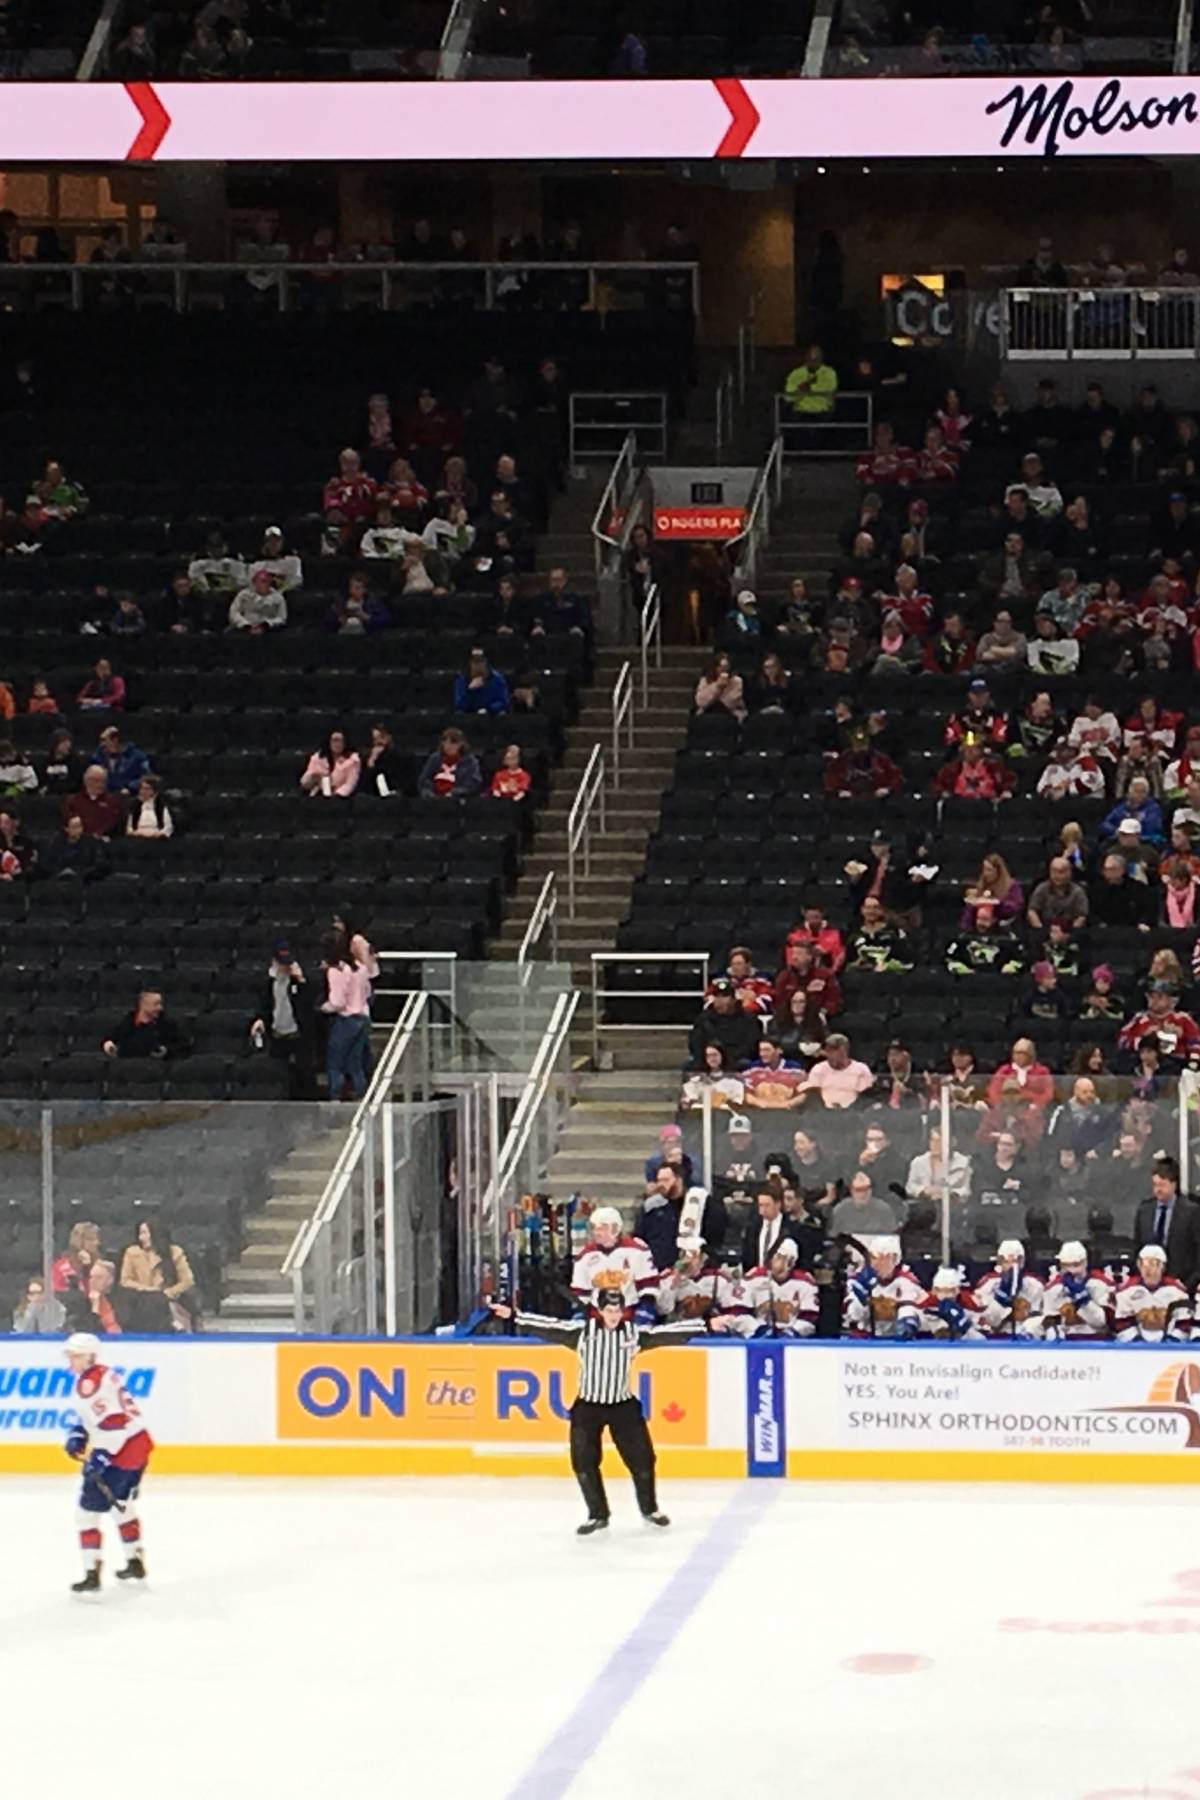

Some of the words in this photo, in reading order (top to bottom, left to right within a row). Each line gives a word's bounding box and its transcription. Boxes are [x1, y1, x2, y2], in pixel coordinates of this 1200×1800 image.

[985, 79, 1198, 156] Molson
[671, 517, 718, 529] ROGERS
[720, 518, 741, 529] PLA
[844, 1363, 877, 1378] Not
[883, 1366, 903, 1378] an
[909, 1363, 993, 1383] Invisalign
[297, 1366, 405, 1418] ON
[426, 1380, 476, 1406] the
[496, 1369, 652, 1421] RU
[886, 1385, 919, 1400] You
[924, 1386, 960, 1400] Are!
[849, 1411, 932, 1429] SPHINX
[939, 1412, 1179, 1435] ORTHODONTICS.COM
